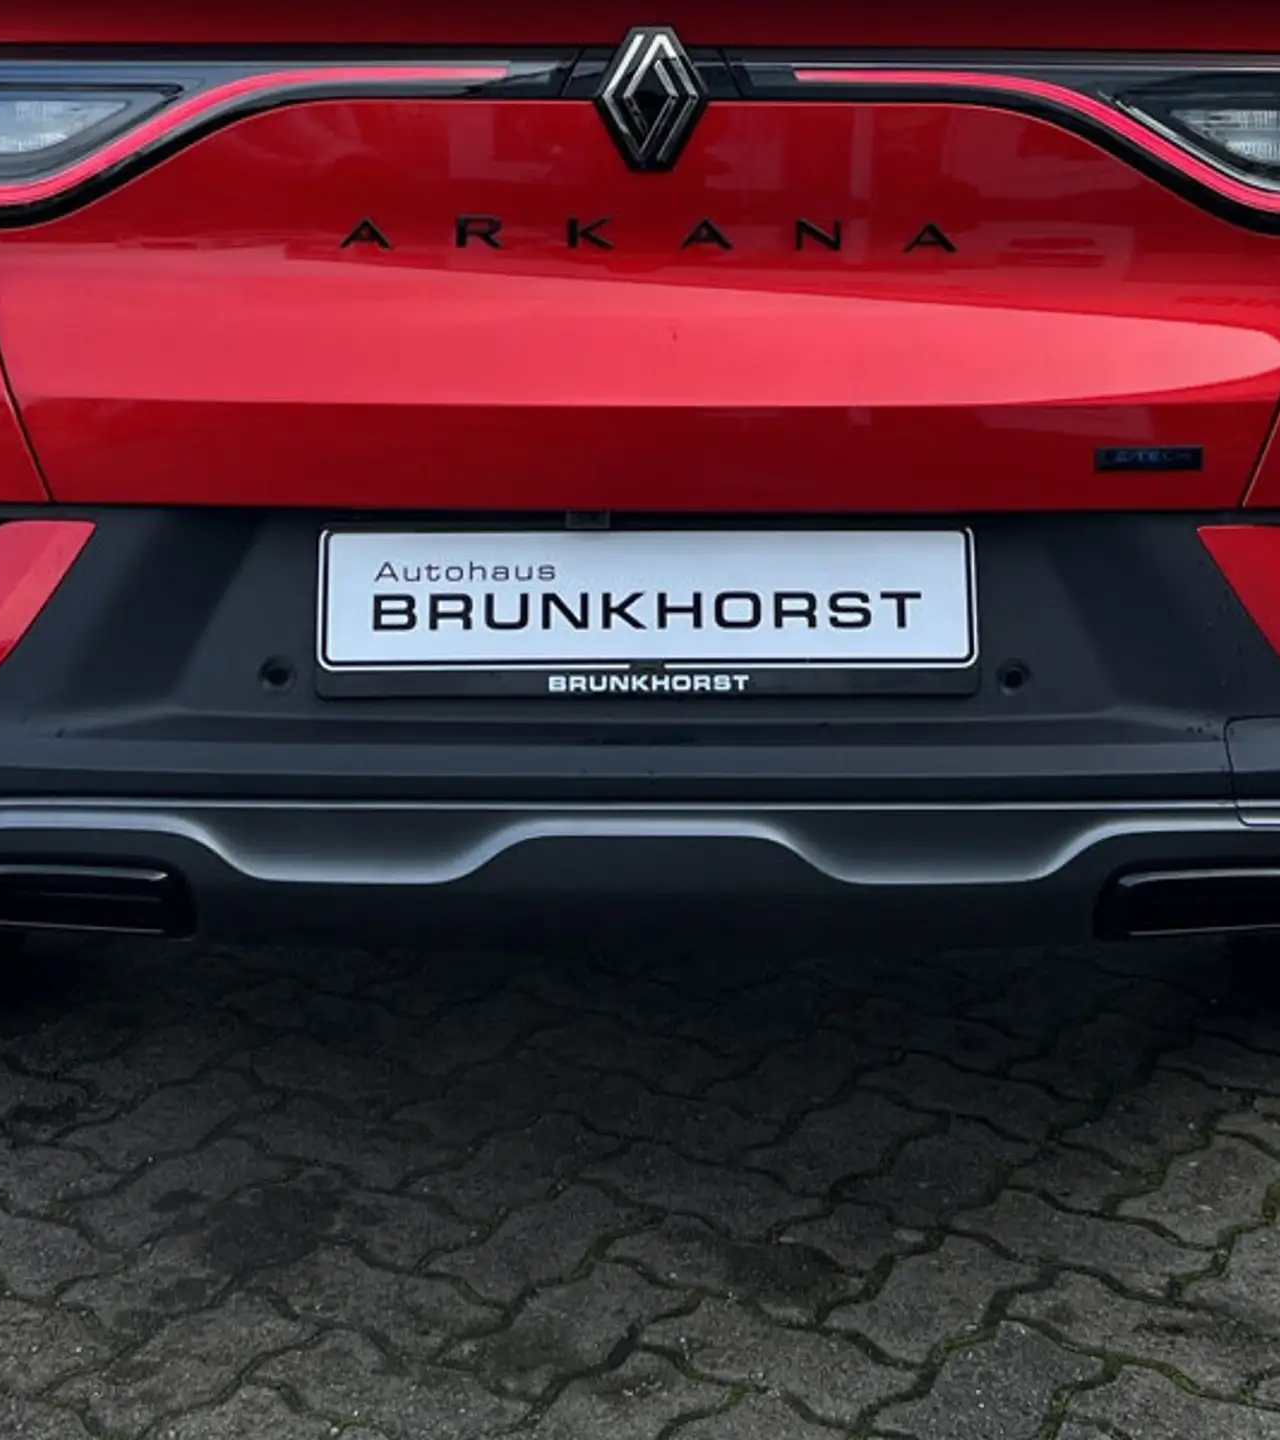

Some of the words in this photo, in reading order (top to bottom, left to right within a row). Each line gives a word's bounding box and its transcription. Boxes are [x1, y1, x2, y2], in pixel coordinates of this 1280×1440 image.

[341, 215, 957, 254] ARKANA
[374, 561, 556, 582] Autohaus
[372, 590, 922, 631] BRUNKHORST
[548, 673, 750, 692] BRUNKHORST
